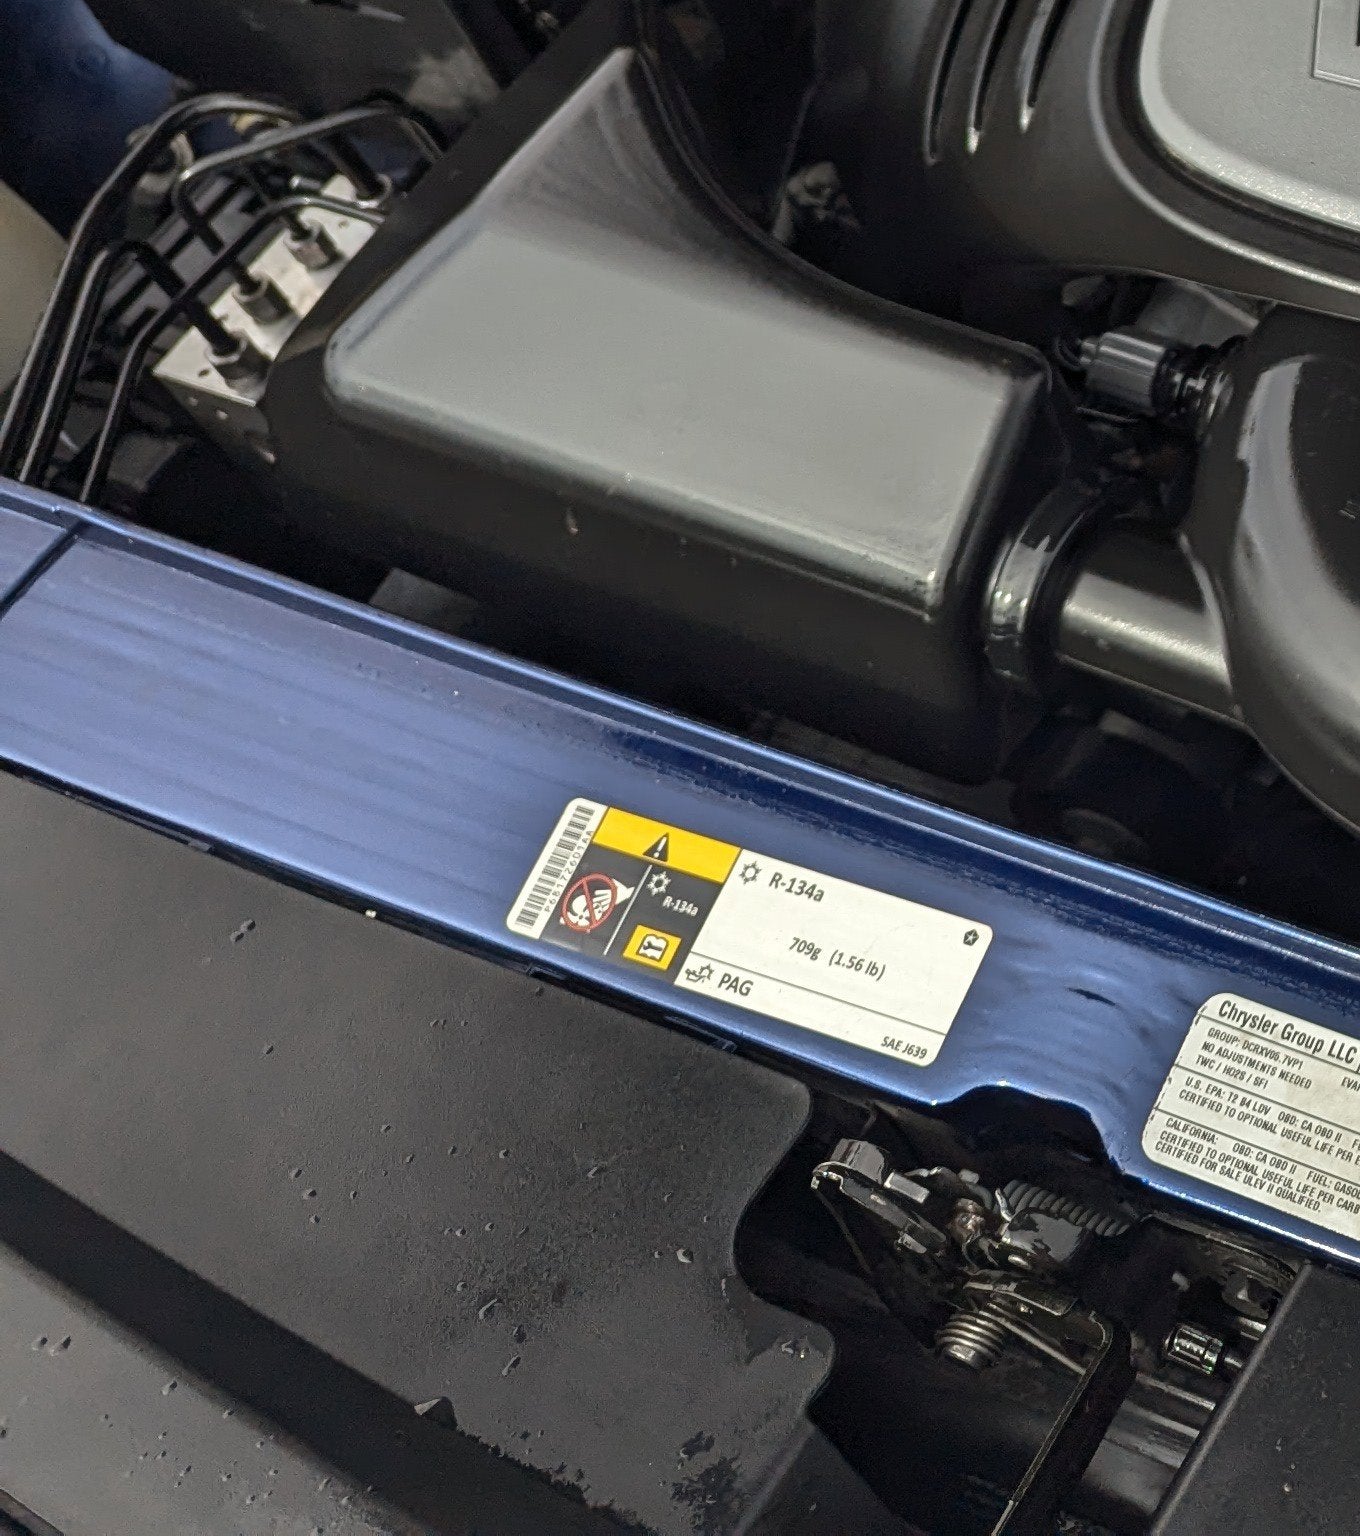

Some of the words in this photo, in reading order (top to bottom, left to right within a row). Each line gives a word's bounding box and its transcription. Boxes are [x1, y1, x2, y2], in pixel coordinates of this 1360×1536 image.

[661, 895, 700, 918] R-134a
[768, 871, 824, 902] R-134a
[789, 936, 822, 960] 709g
[828, 949, 865, 971] (1.56
[864, 960, 885, 981] lb)
[717, 972, 753, 996] PAG
[880, 1035, 903, 1051] SAE
[901, 1042, 927, 1059] J639
[1207, 1027, 1240, 1047] GROUP:
[1218, 999, 1279, 1035] Chrysler
[1280, 1022, 1324, 1055] Group
[1326, 1039, 1357, 1064] LLC
[1195, 1054, 1215, 1069] TWC
[1214, 1061, 1222, 1071] /
[1245, 1073, 1252, 1083] /
[1252, 1075, 1268, 1089] SFI
[1200, 1040, 1215, 1053] NO
[1214, 1046, 1277, 1076] ADJUSTMENTS
[1277, 1068, 1312, 1089] NEEDED
[1178, 1088, 1223, 1112] CERTIFIED
[1223, 1105, 1236, 1118] TO
[1236, 1110, 1280, 1134] OPTIONAL
[1280, 1126, 1312, 1147] USEFUL
[1313, 1139, 1335, 1155] LIFE
[1334, 1147, 1353, 1162] PER
[1184, 1075, 1202, 1091] U.S.
[1204, 1083, 1225, 1099] EPA:
[1251, 1100, 1271, 1115] LDV
[1277, 1110, 1299, 1127] OBD:
[1300, 1119, 1312, 1132] CA
[1313, 1124, 1333, 1139] OBD
[1154, 1140, 1199, 1164] CERTIFIED
[1198, 1157, 1218, 1172] FOR
[1218, 1164, 1242, 1181] SALE
[1242, 1173, 1266, 1190] ULEV
[1274, 1186, 1321, 1212] QUALIFIED.
[1159, 1129, 1203, 1154] CERTIFIED
[1204, 1146, 1217, 1159] TO
[1217, 1152, 1258, 1176] OPTIONAL
[1261, 1168, 1293, 1189] USEFUL
[1295, 1181, 1316, 1197] LIFE
[1316, 1189, 1335, 1205] PER
[1335, 1197, 1360, 1214] CARB
[1165, 1117, 1218, 1145] CALIFORNIA:
[1232, 1142, 1253, 1158] OBD:
[1254, 1150, 1267, 1164] CA
[1268, 1156, 1288, 1171] OBD
[1305, 1170, 1332, 1188] FUEL:
